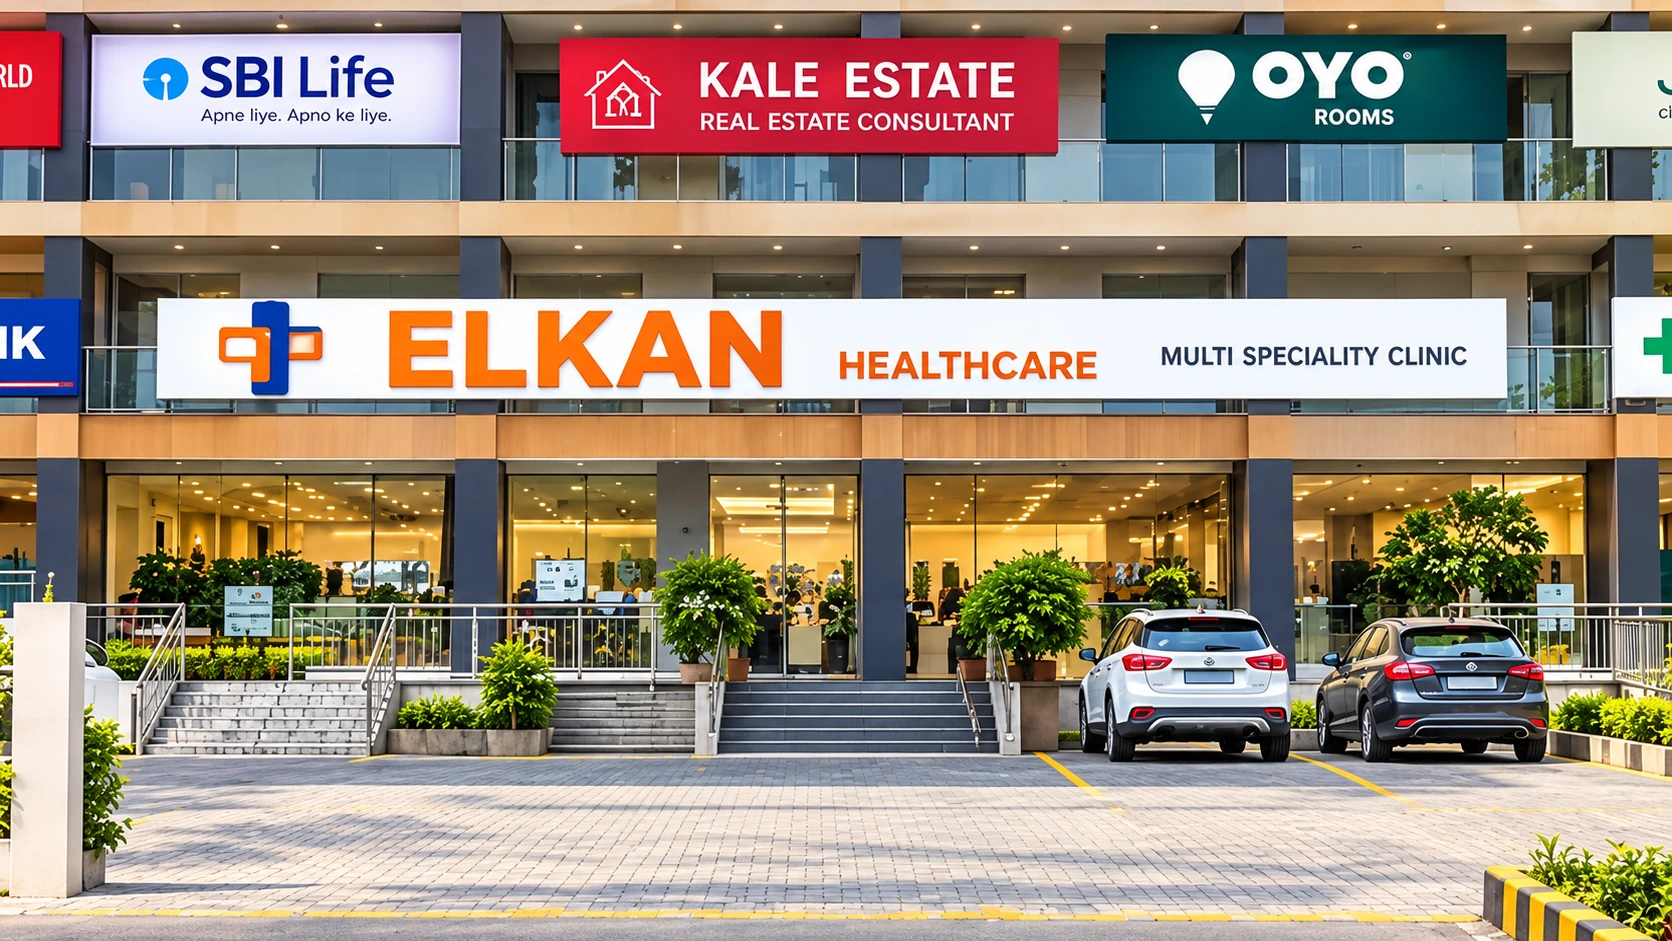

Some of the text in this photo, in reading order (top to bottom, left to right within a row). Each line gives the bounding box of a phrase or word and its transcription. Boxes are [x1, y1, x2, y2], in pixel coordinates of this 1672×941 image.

[201, 55, 394, 98] SBI Life
[701, 62, 1015, 98] KALE ESTATE
[1253, 51, 1404, 99] OYO
[201, 108, 392, 125] Apne liye. Apno ke liye.
[701, 113, 1015, 131] REAL ESTATE CONSULTANT
[1315, 109, 1395, 126] ROOMS
[0, 326, 46, 360] K
[389, 310, 1468, 389] ELKAN HEALTHCARE MULTI SPECIALITY CLINIC
